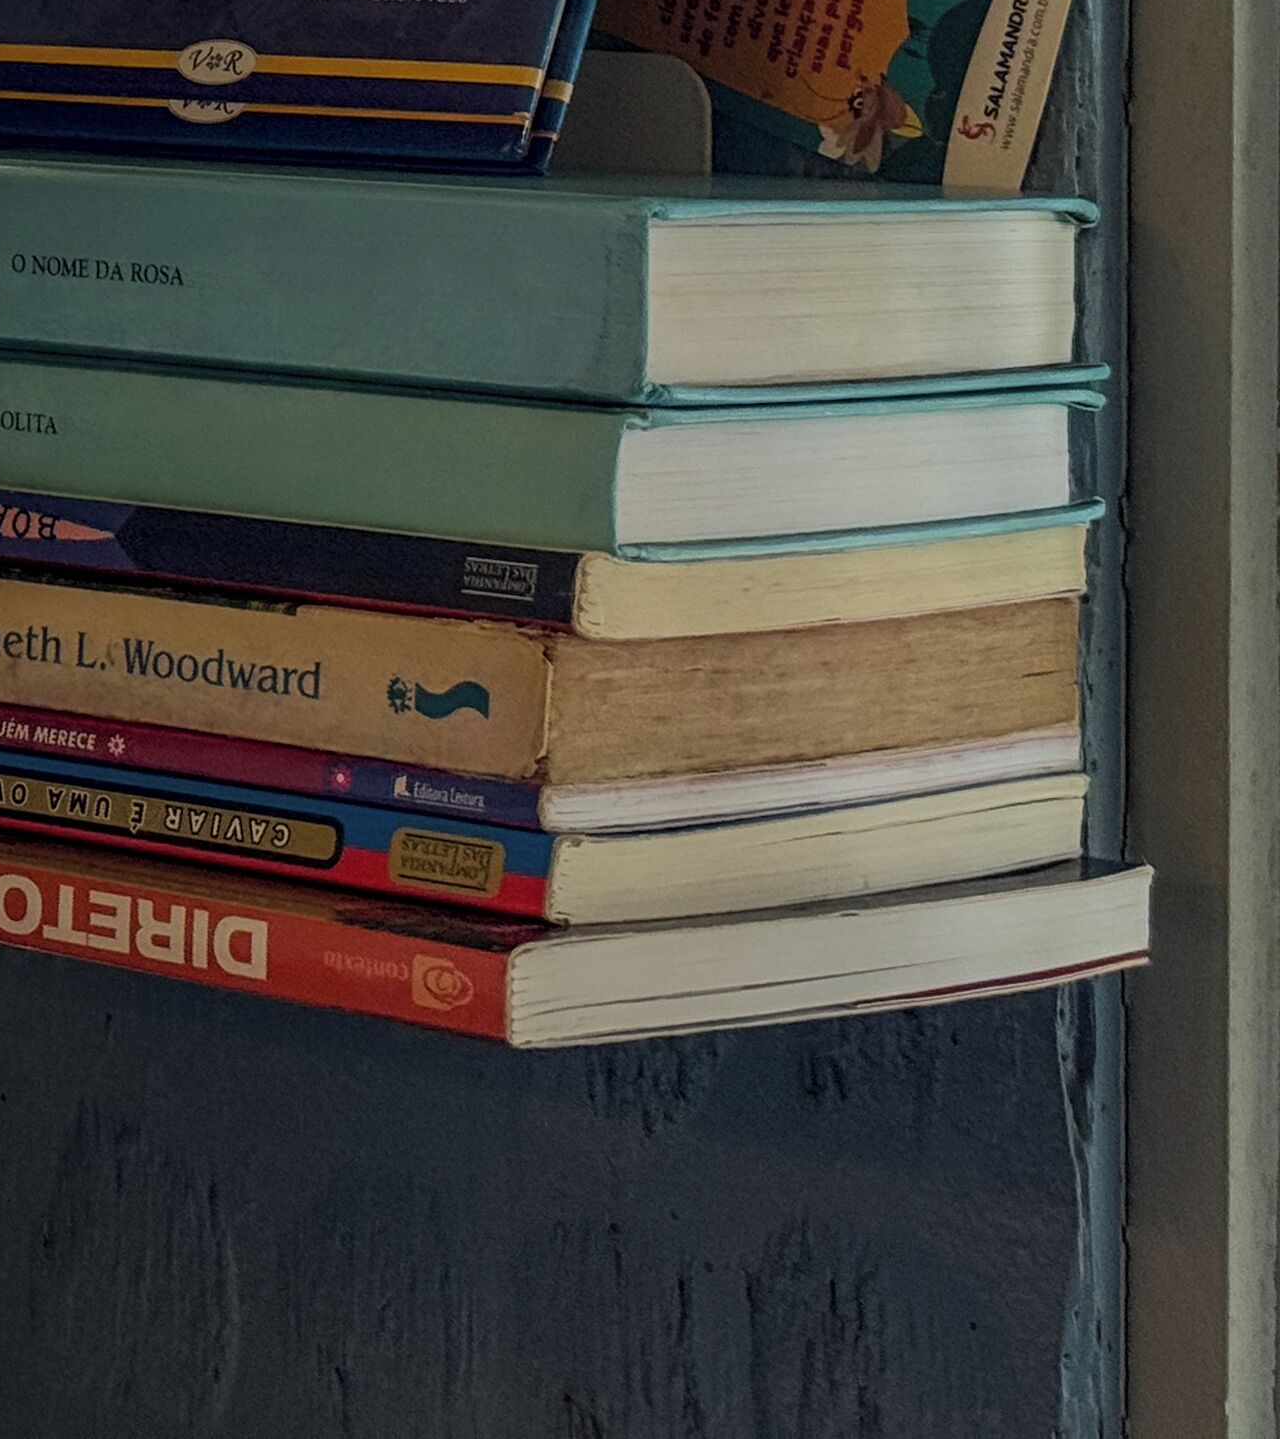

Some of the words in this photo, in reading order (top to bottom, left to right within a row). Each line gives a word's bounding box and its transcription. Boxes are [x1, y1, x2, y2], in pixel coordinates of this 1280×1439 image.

[724, 5, 744, 48] com
[767, 21, 786, 62] que
[812, 24, 834, 74] suas
[11, 253, 26, 274] O
[32, 254, 89, 279] NOME
[95, 260, 124, 281] DA
[130, 262, 185, 286] ROSA
[76, 631, 107, 670] L.
[124, 638, 321, 699] Woodward
[34, 726, 96, 751] MERECE
[47, 787, 111, 819] UMA
[414, 781, 448, 802] Editora
[129, 800, 145, 833] É
[165, 803, 290, 847] CAVIAR
[324, 950, 409, 981] contexto
